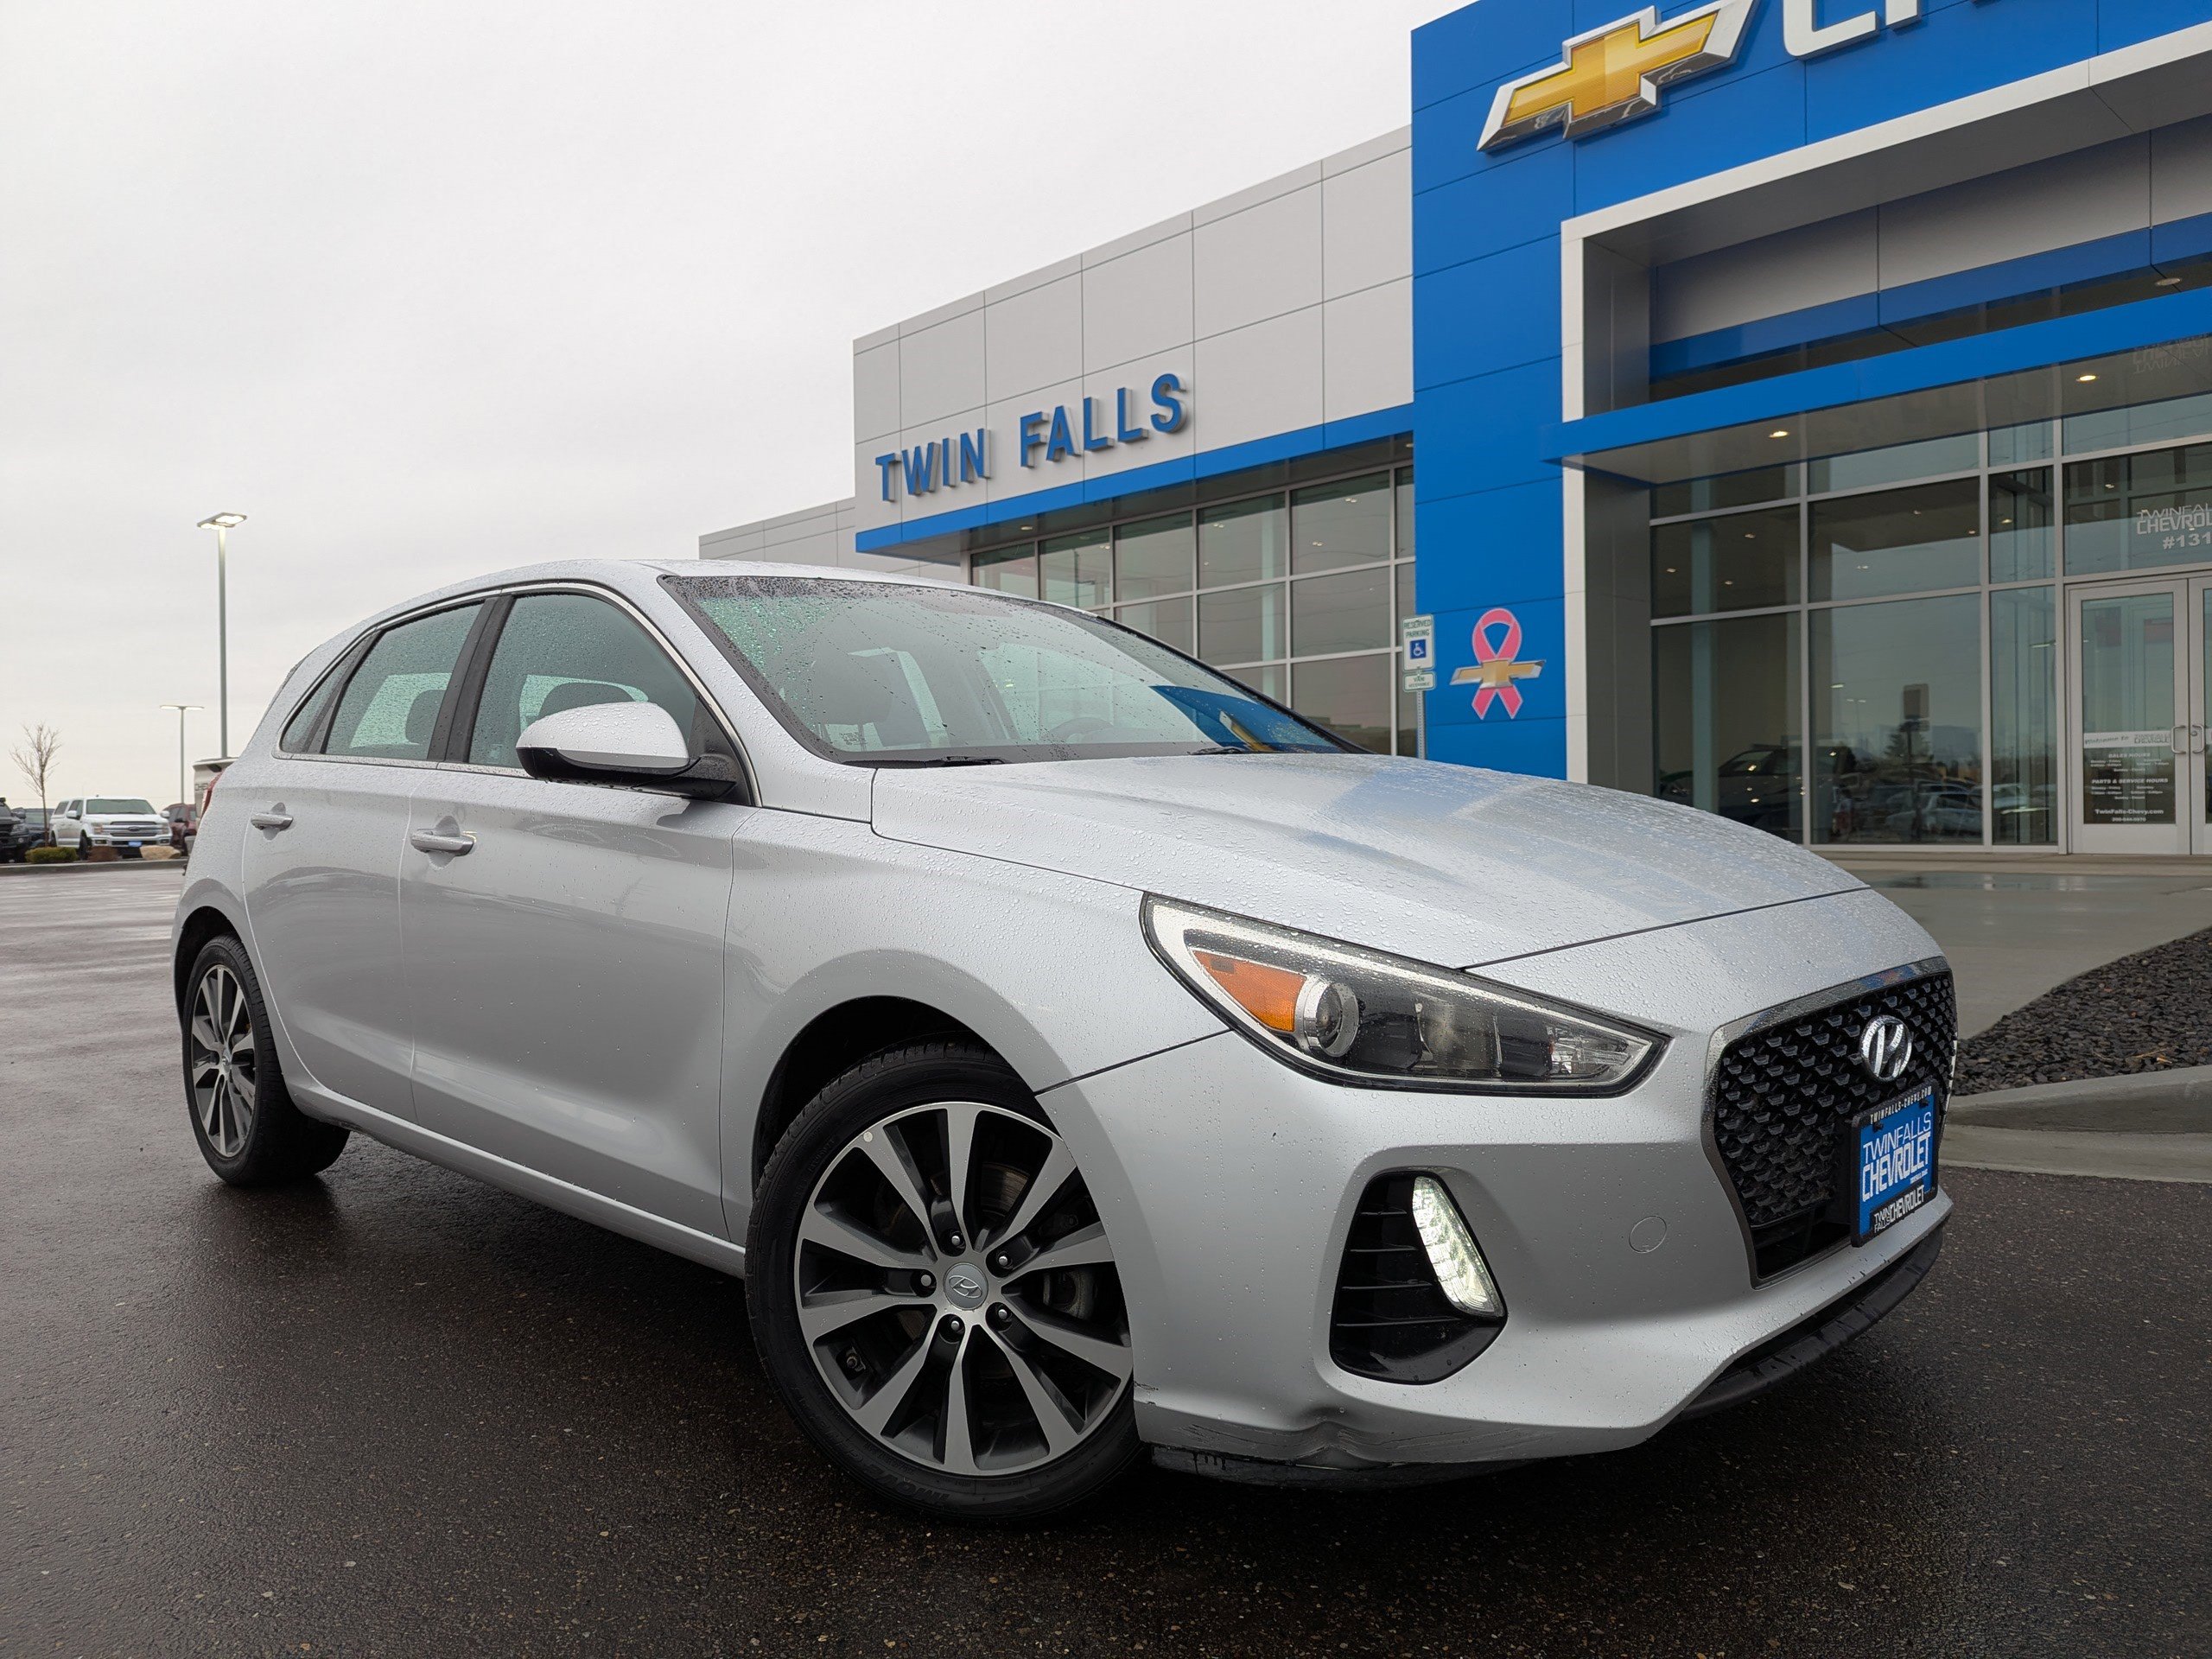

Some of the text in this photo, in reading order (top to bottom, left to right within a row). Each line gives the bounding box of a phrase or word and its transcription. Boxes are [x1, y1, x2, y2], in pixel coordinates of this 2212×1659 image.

[875, 373, 1186, 502] TWIN FALLS
[1403, 620, 1432, 629] RESERVED
[1406, 629, 1430, 638] PARKING
[1863, 1111, 1932, 1164] TWINFALLS
[1862, 1131, 1931, 1202] CHEVROLET
[1889, 1185, 1925, 1223] CHEVROLET
